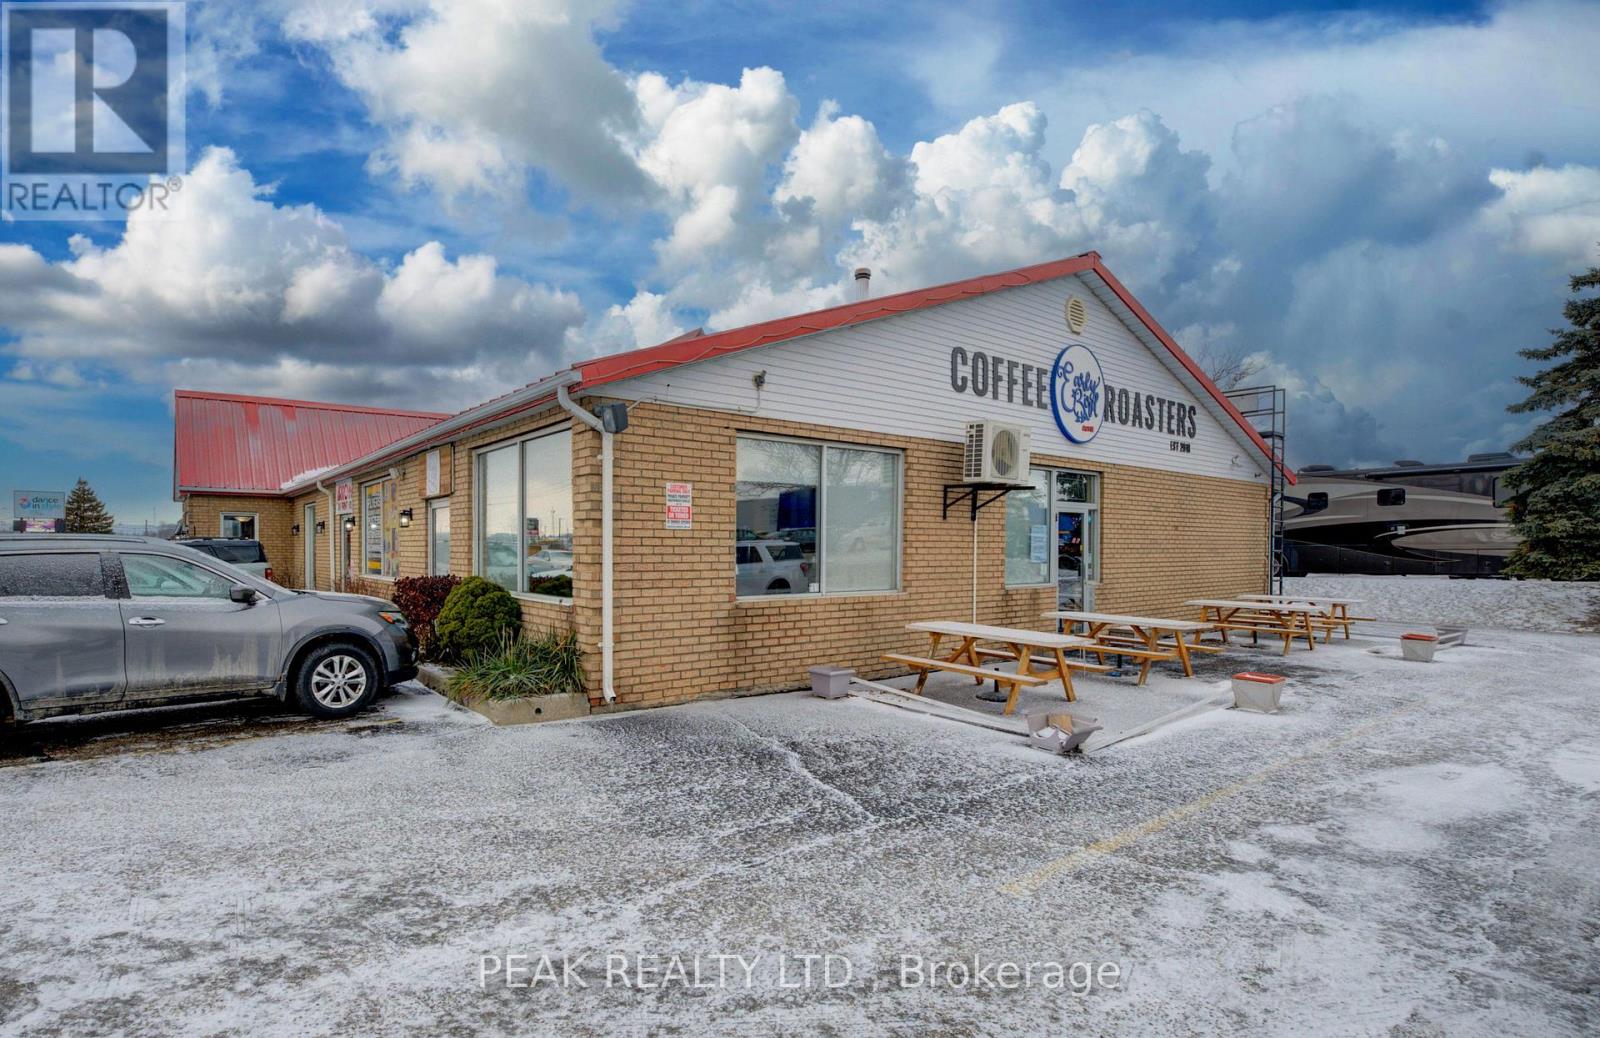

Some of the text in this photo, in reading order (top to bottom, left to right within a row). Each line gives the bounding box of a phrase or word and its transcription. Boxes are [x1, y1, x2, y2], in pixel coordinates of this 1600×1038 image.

[951, 346, 1048, 410] COFFEE
[1104, 384, 1197, 439] ROASTERS
[31, 496, 58, 504] dance
